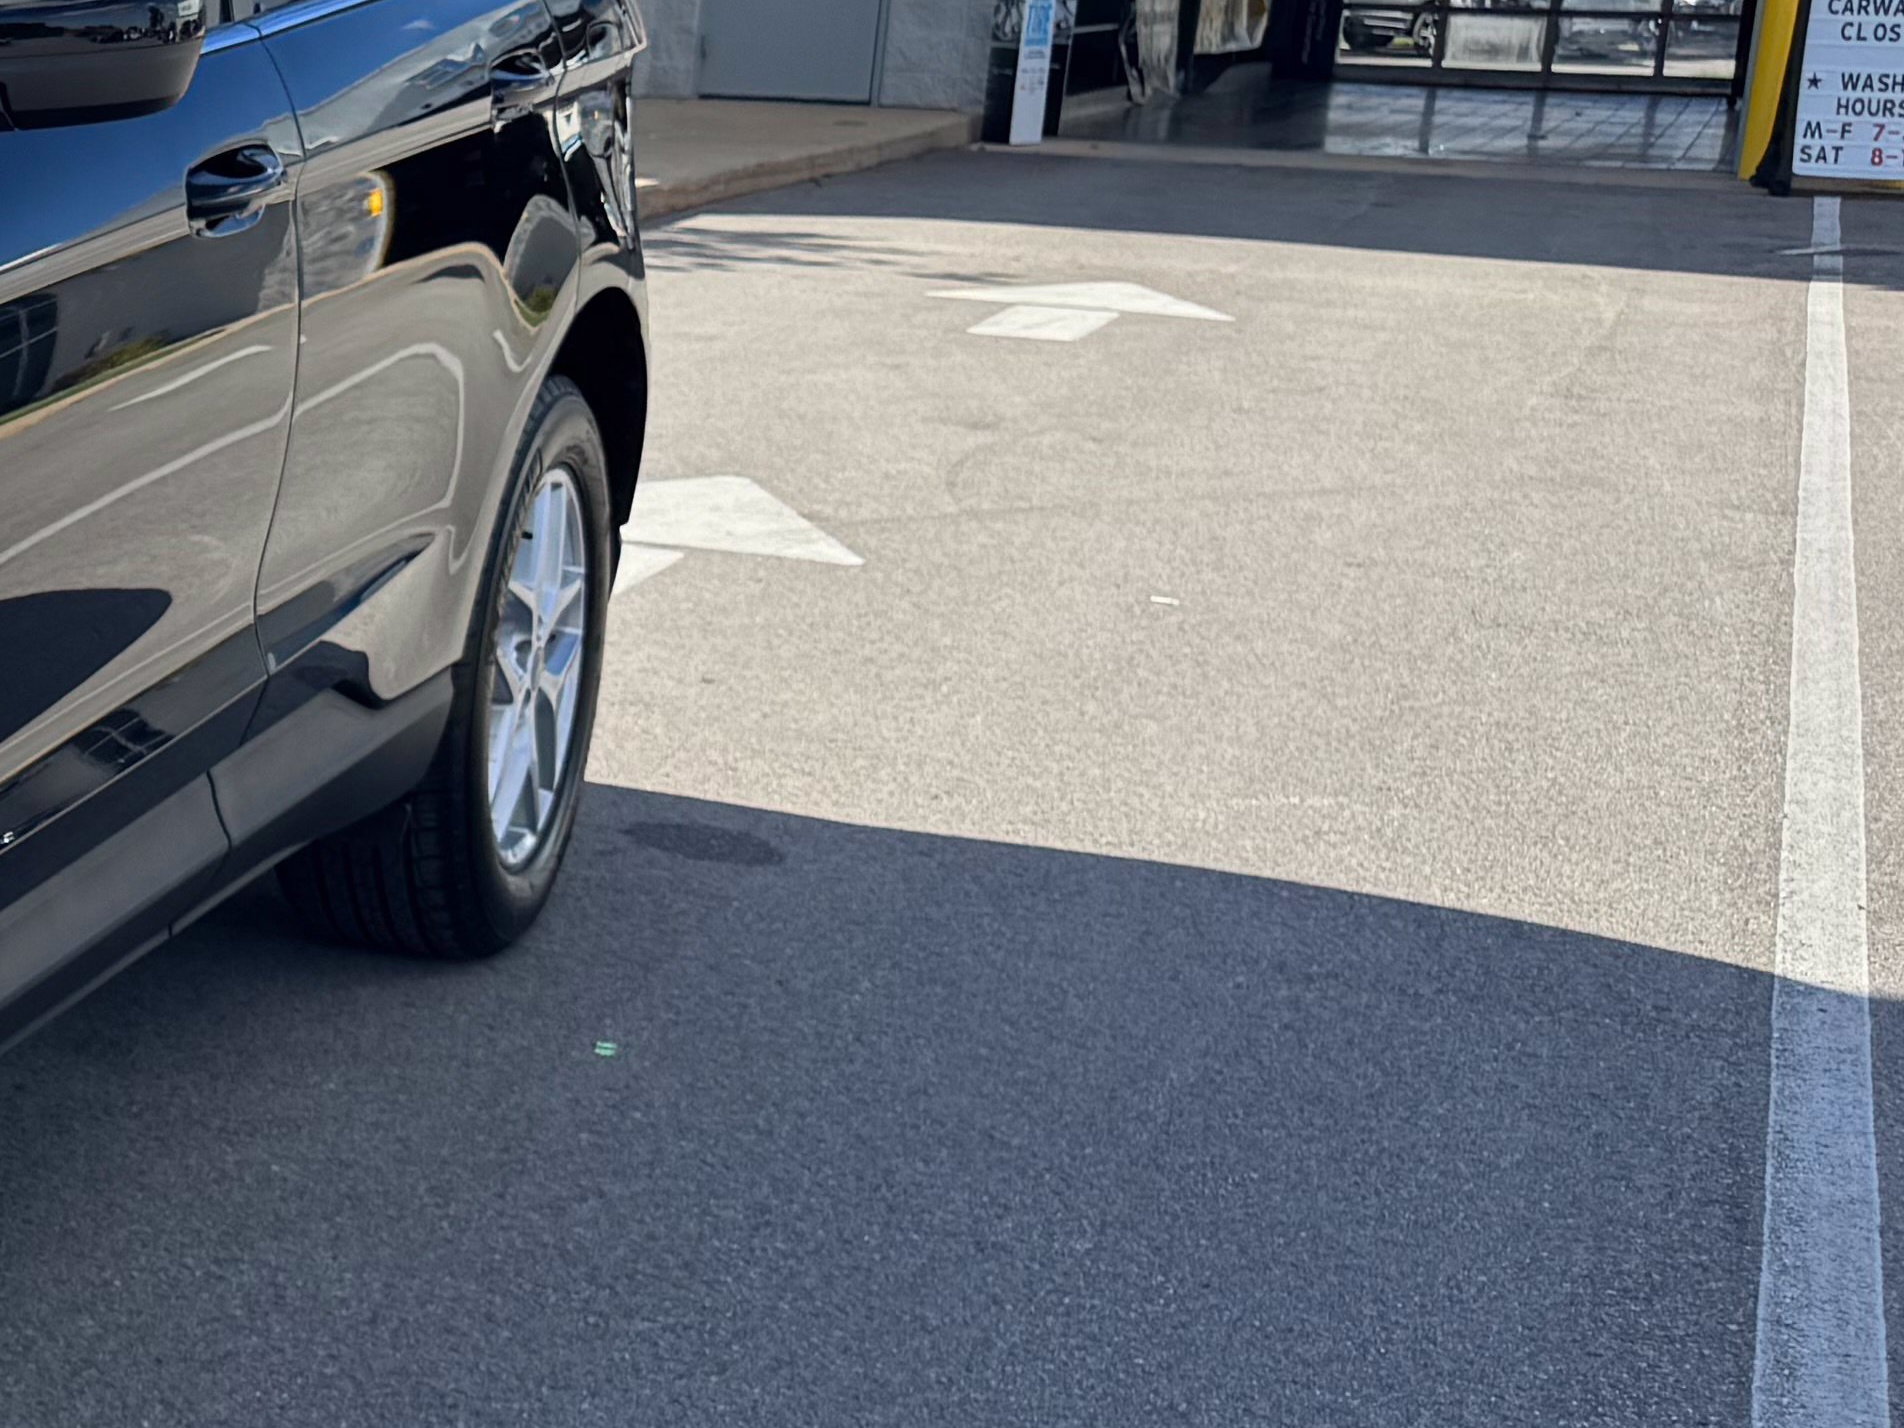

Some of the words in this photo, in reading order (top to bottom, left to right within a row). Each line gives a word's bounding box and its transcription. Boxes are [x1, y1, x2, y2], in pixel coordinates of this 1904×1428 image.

[1840, 22, 1901, 43] CLOS
[1841, 72, 1904, 93] WASH
[1802, 121, 1853, 140] M-F
[1872, 123, 1904, 142] 7-
[1799, 145, 1844, 165] SAT
